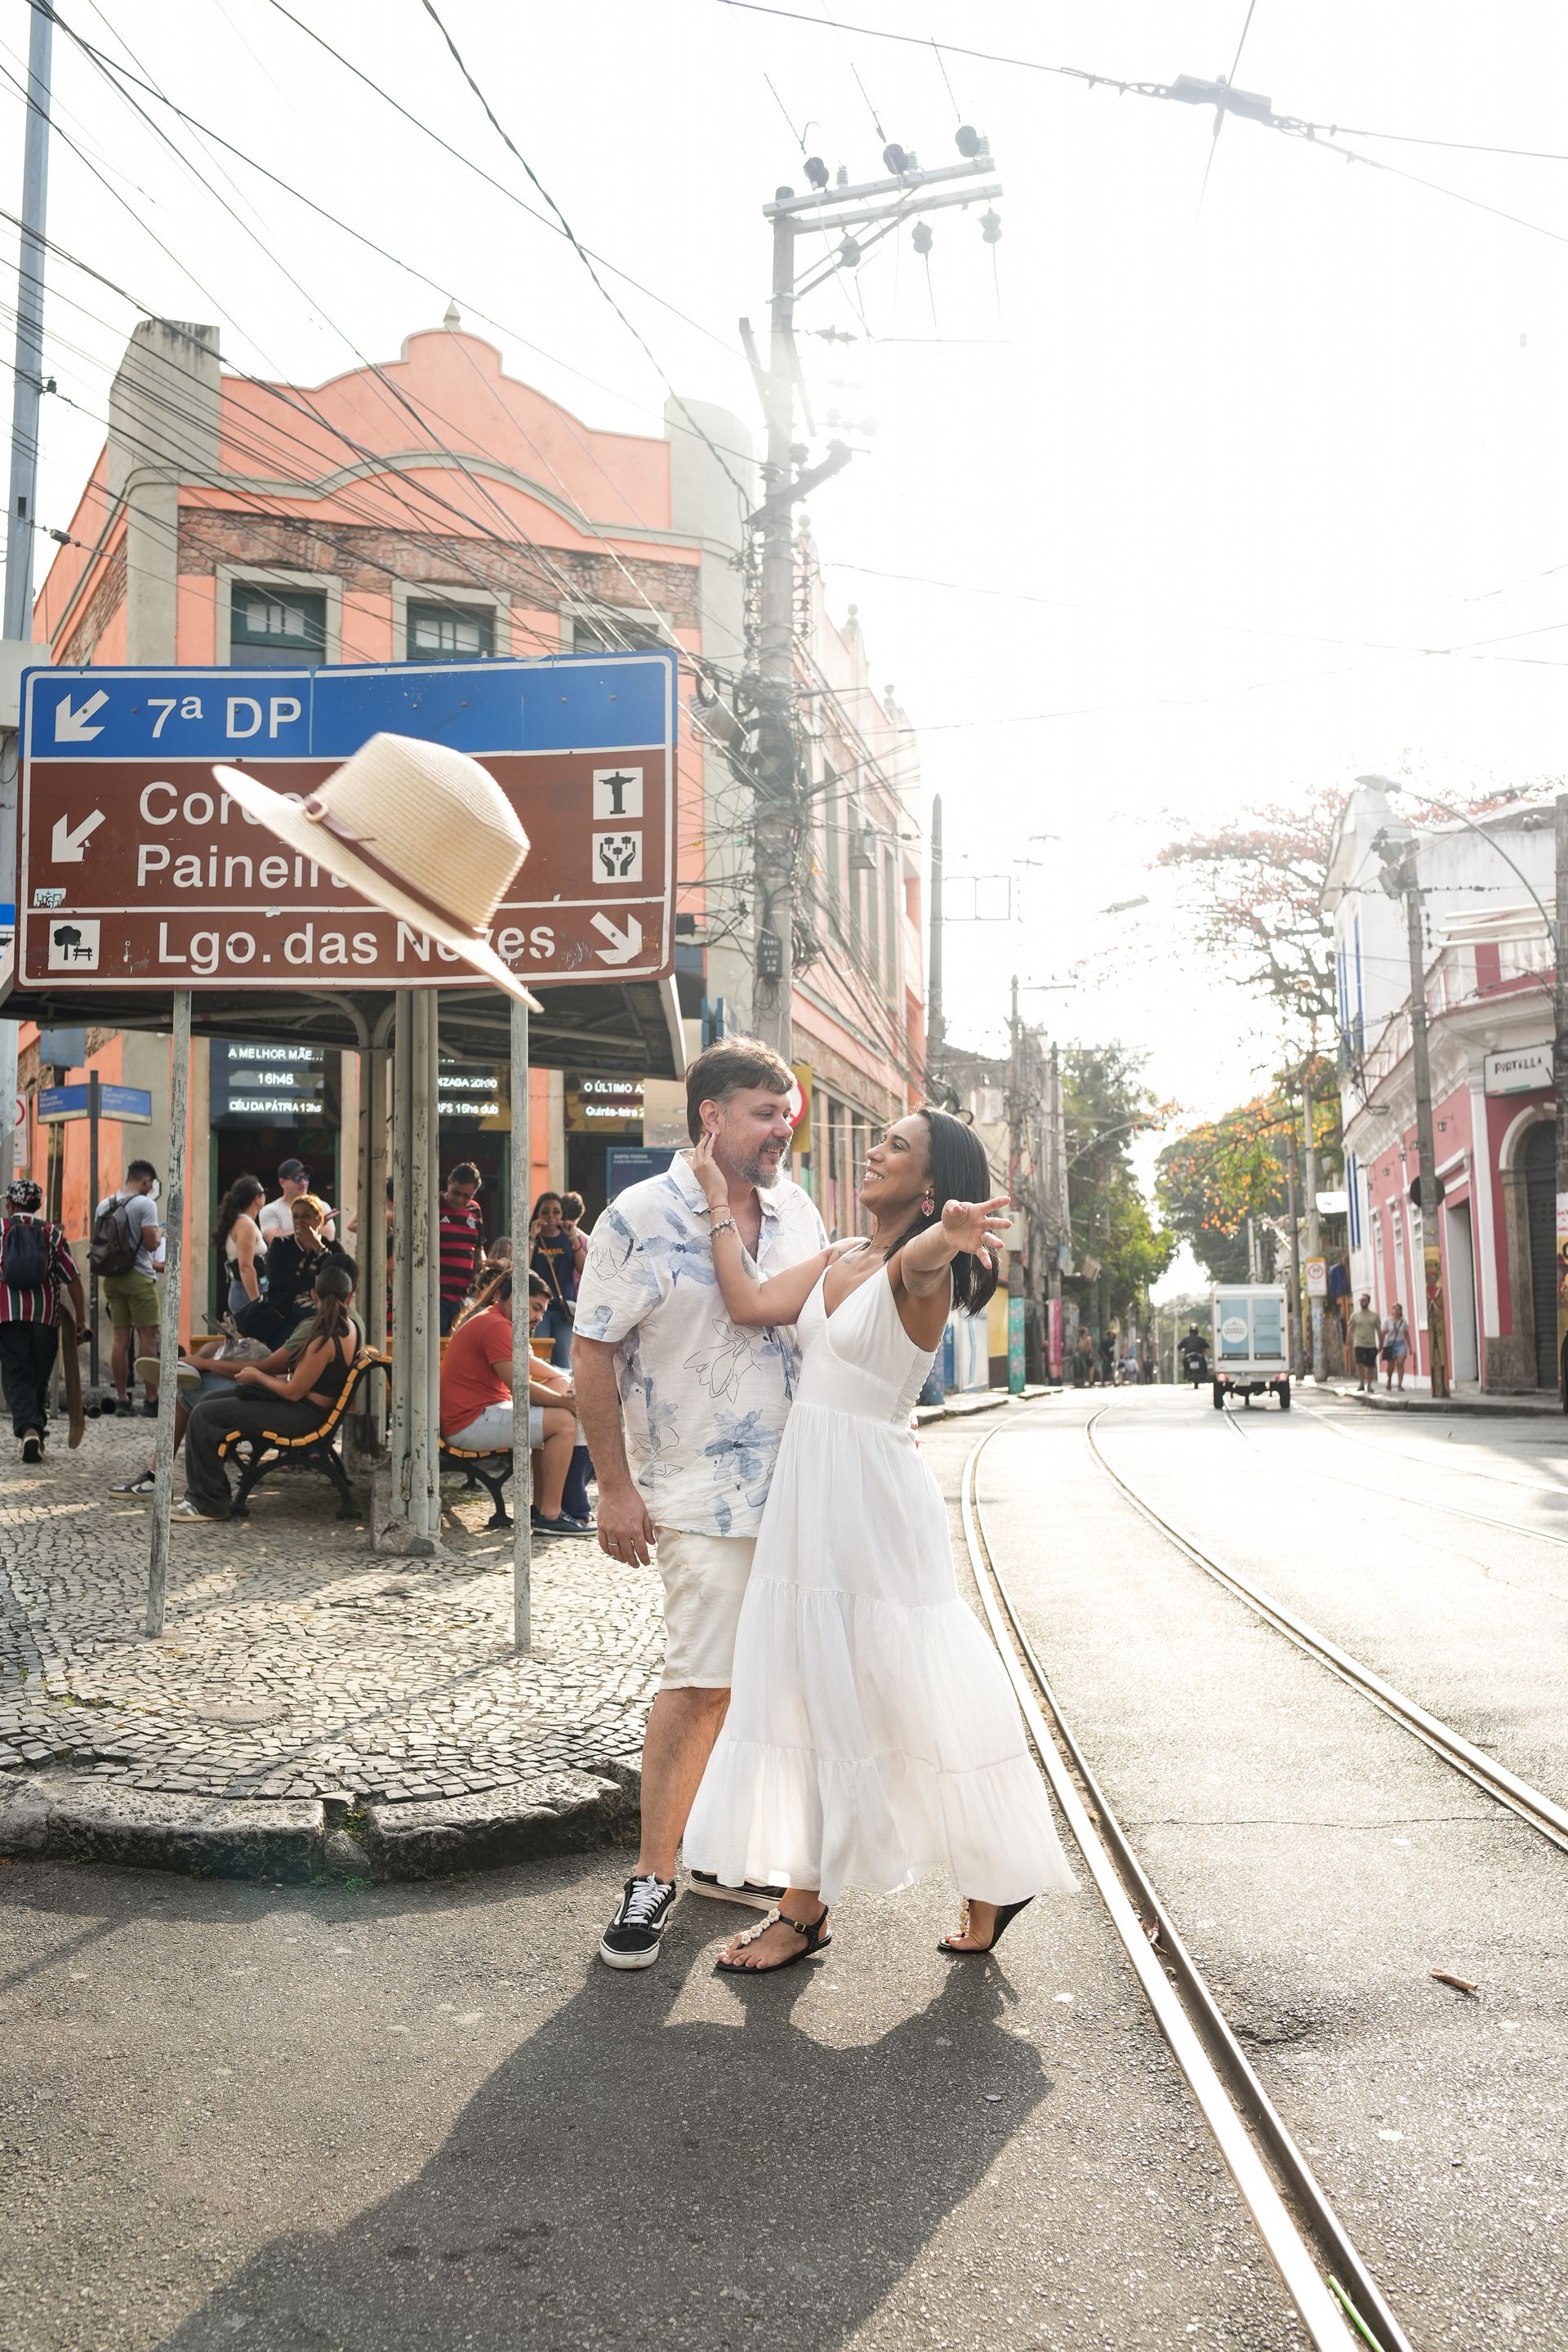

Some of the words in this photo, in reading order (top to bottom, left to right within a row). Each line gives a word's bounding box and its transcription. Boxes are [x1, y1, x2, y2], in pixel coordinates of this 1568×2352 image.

[226, 697, 301, 738] DP
[158, 922, 271, 975] Lgo.
[283, 923, 378, 964] das
[228, 1047, 238, 1058] A
[238, 1048, 287, 1060] MELHOR
[257, 1072, 294, 1085] 16h45
[584, 1082, 593, 1093] O
[595, 1080, 633, 1094] ÚLTIMO
[229, 1098, 250, 1111] CÉU
[250, 1101, 265, 1111] DA
[480, 1104, 499, 1115] dub
[586, 1106, 638, 1118] Quinta-feira
